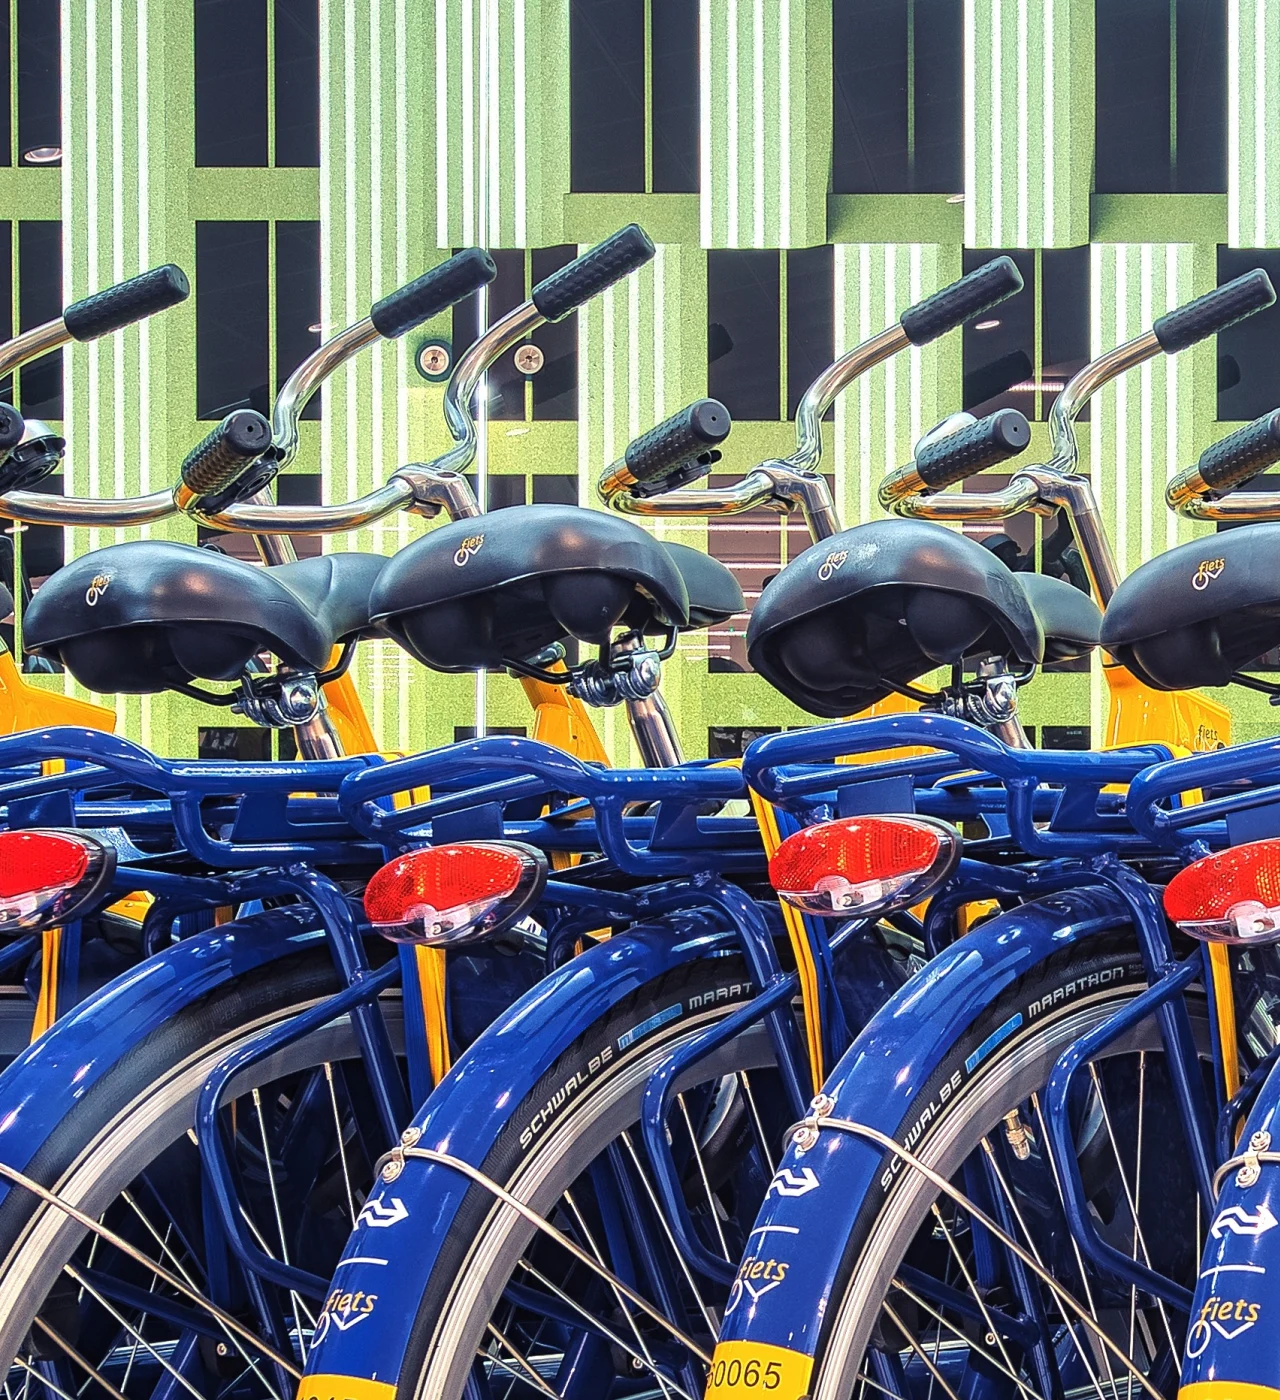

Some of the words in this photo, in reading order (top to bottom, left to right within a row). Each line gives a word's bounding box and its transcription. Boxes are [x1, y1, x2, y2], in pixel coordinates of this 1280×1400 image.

[1199, 558, 1225, 582] fiets
[518, 1045, 614, 1150] SCHWALBE
[880, 1069, 963, 1193] SCHWALBE
[1027, 966, 1125, 1019] MARATHON
[731, 1256, 790, 1297] fiets
[320, 1288, 378, 1330] fiets
[1195, 1297, 1261, 1340] fiets
